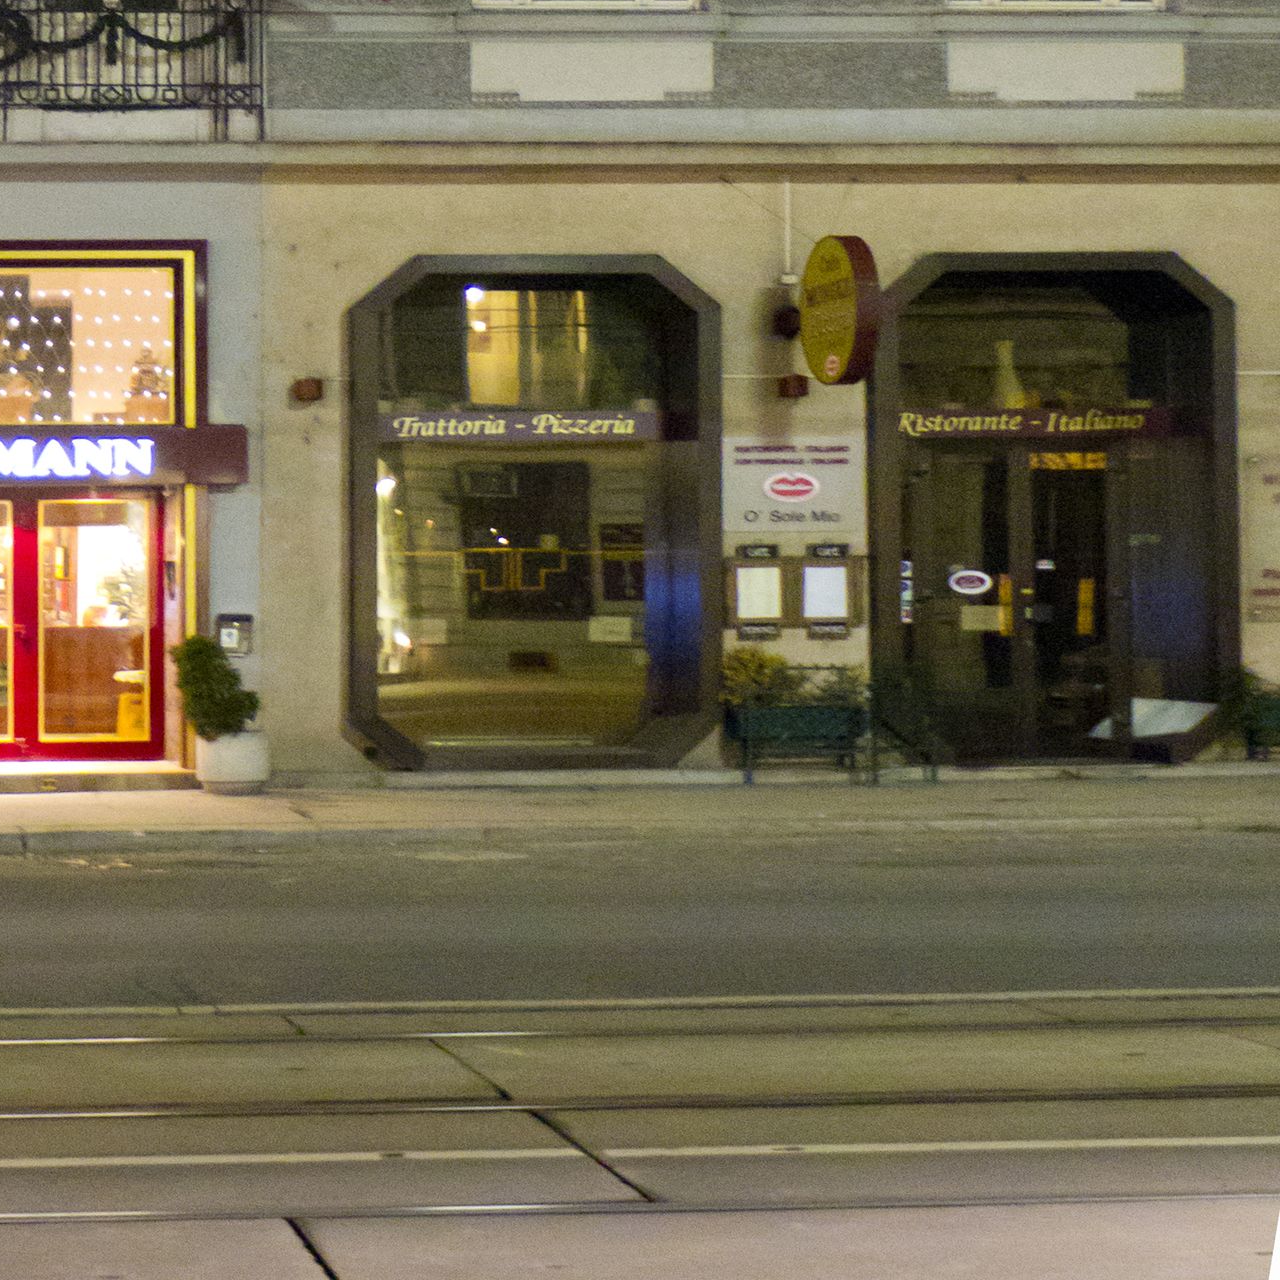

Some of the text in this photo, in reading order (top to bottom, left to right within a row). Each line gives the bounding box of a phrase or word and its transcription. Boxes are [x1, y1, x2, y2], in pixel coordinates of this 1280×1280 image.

[393, 414, 506, 438] Trattoria
[531, 413, 635, 435] Pizzeria
[898, 412, 1022, 437] Ristorante
[1047, 409, 1145, 433] Italiano
